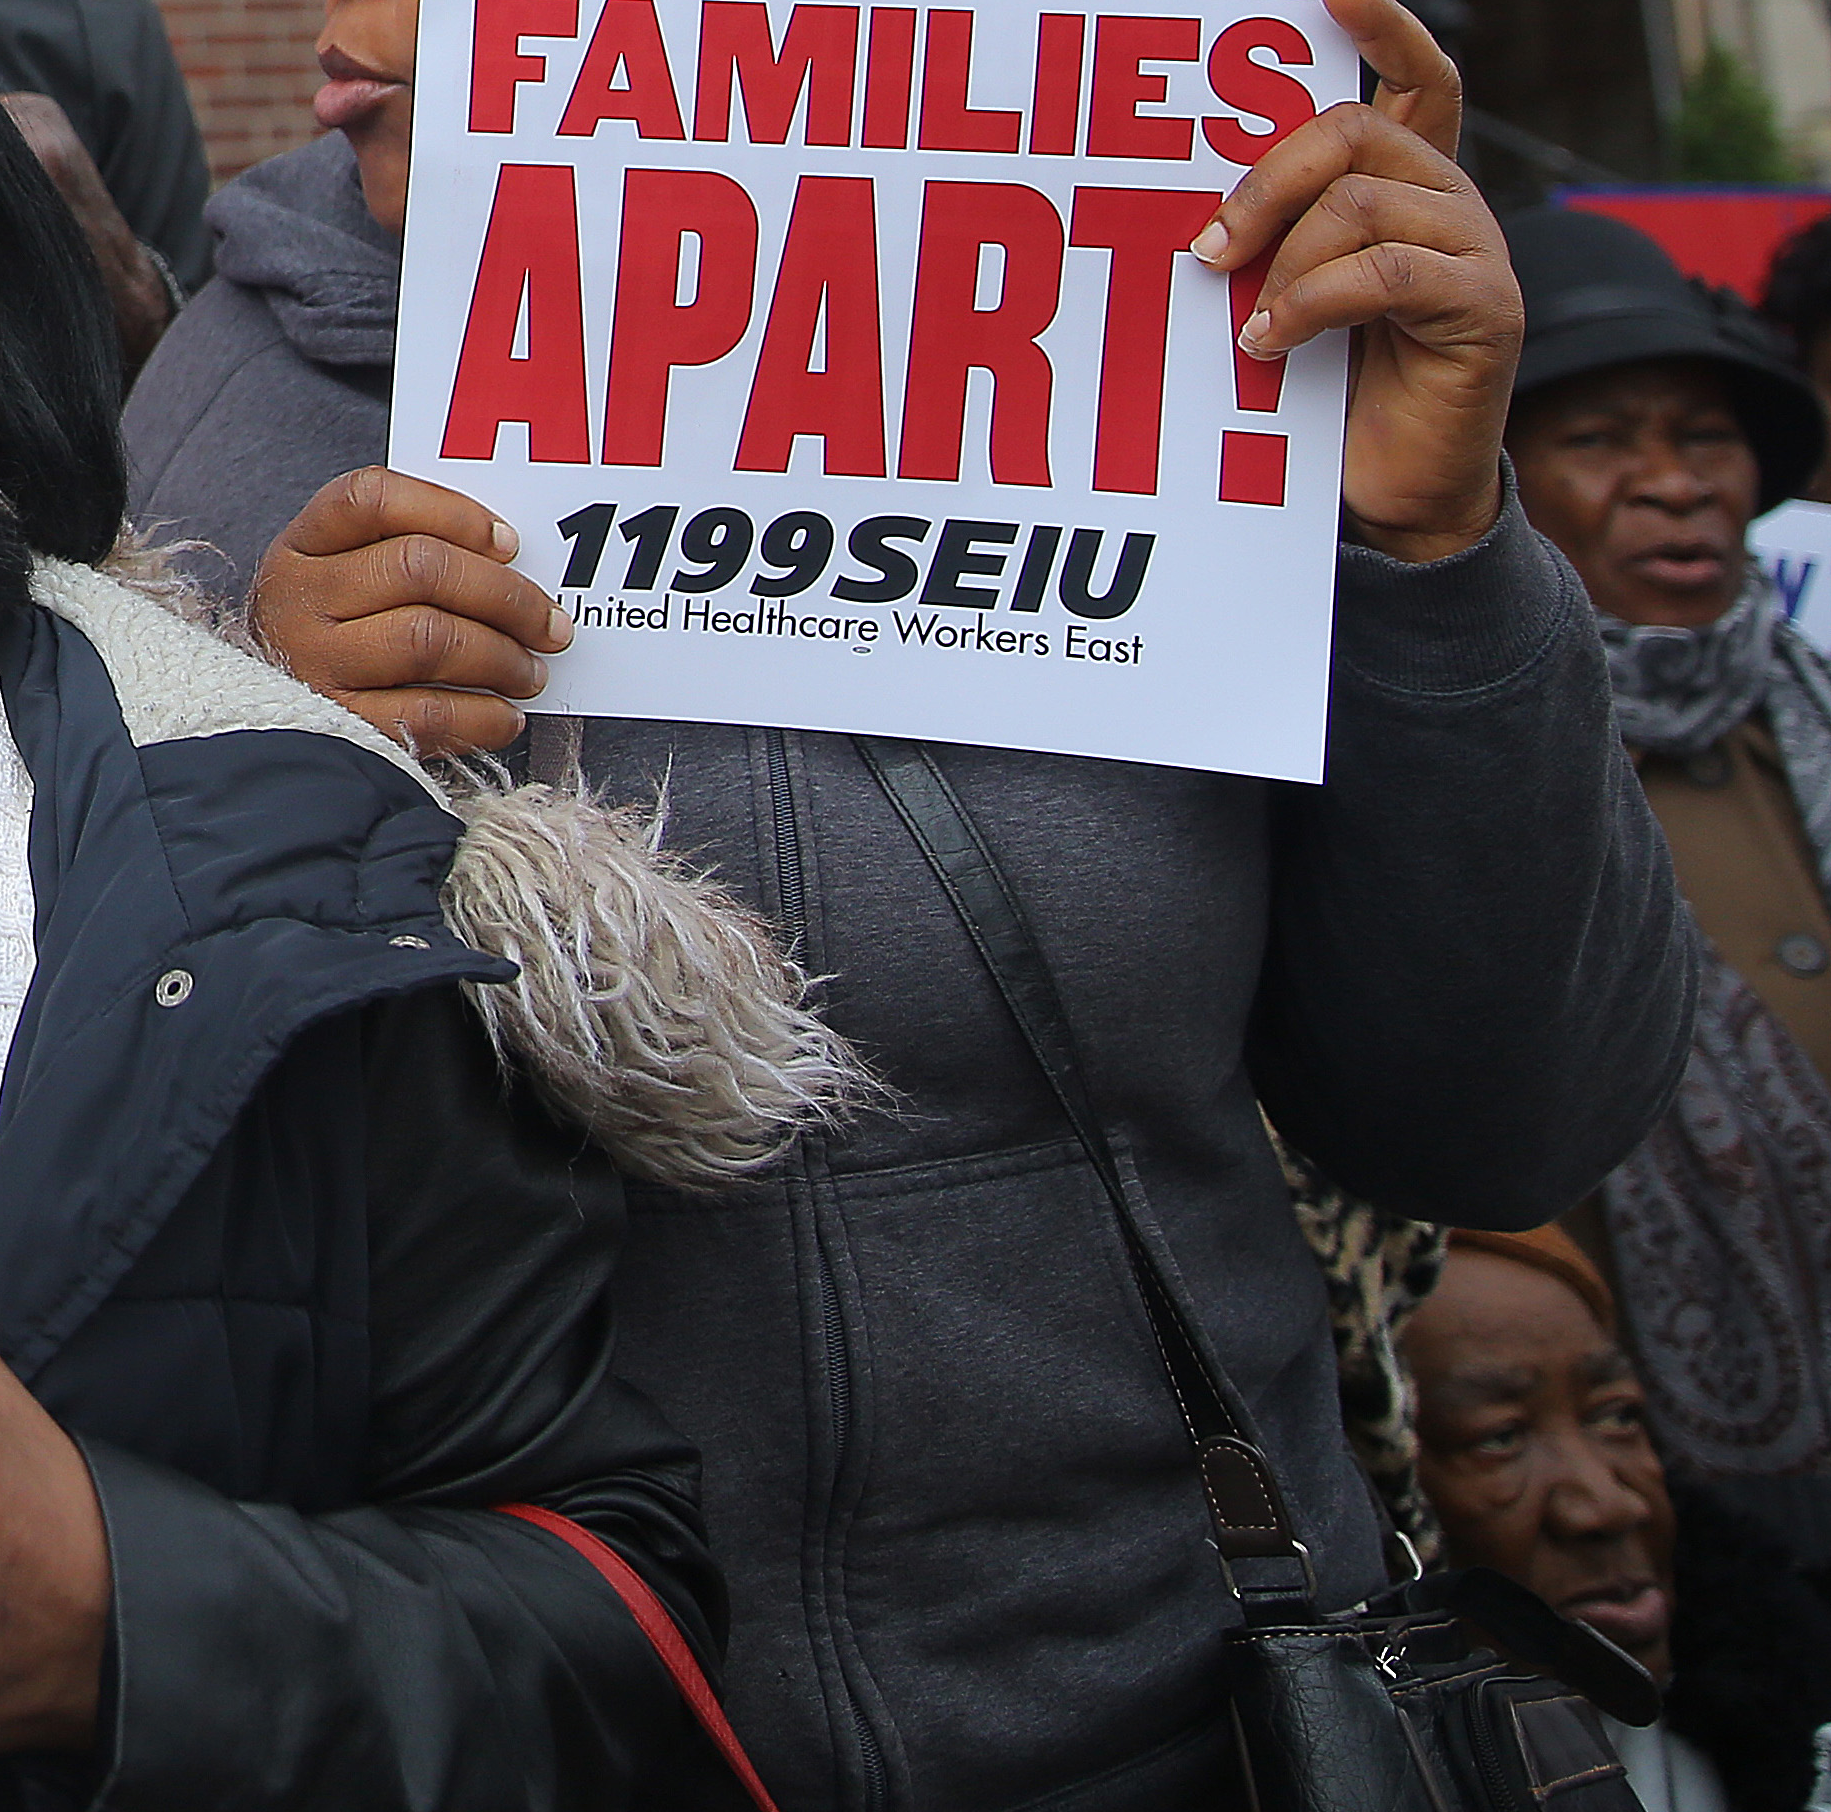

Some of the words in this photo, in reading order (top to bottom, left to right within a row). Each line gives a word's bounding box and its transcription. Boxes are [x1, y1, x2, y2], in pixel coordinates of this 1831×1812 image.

[439, 161, 1290, 507] APART!
[556, 501, 1157, 621] 1199SEIU
[683, 599, 879, 643] Healthcare
[891, 610, 1050, 657] Workers
[1065, 625, 1144, 665] East
